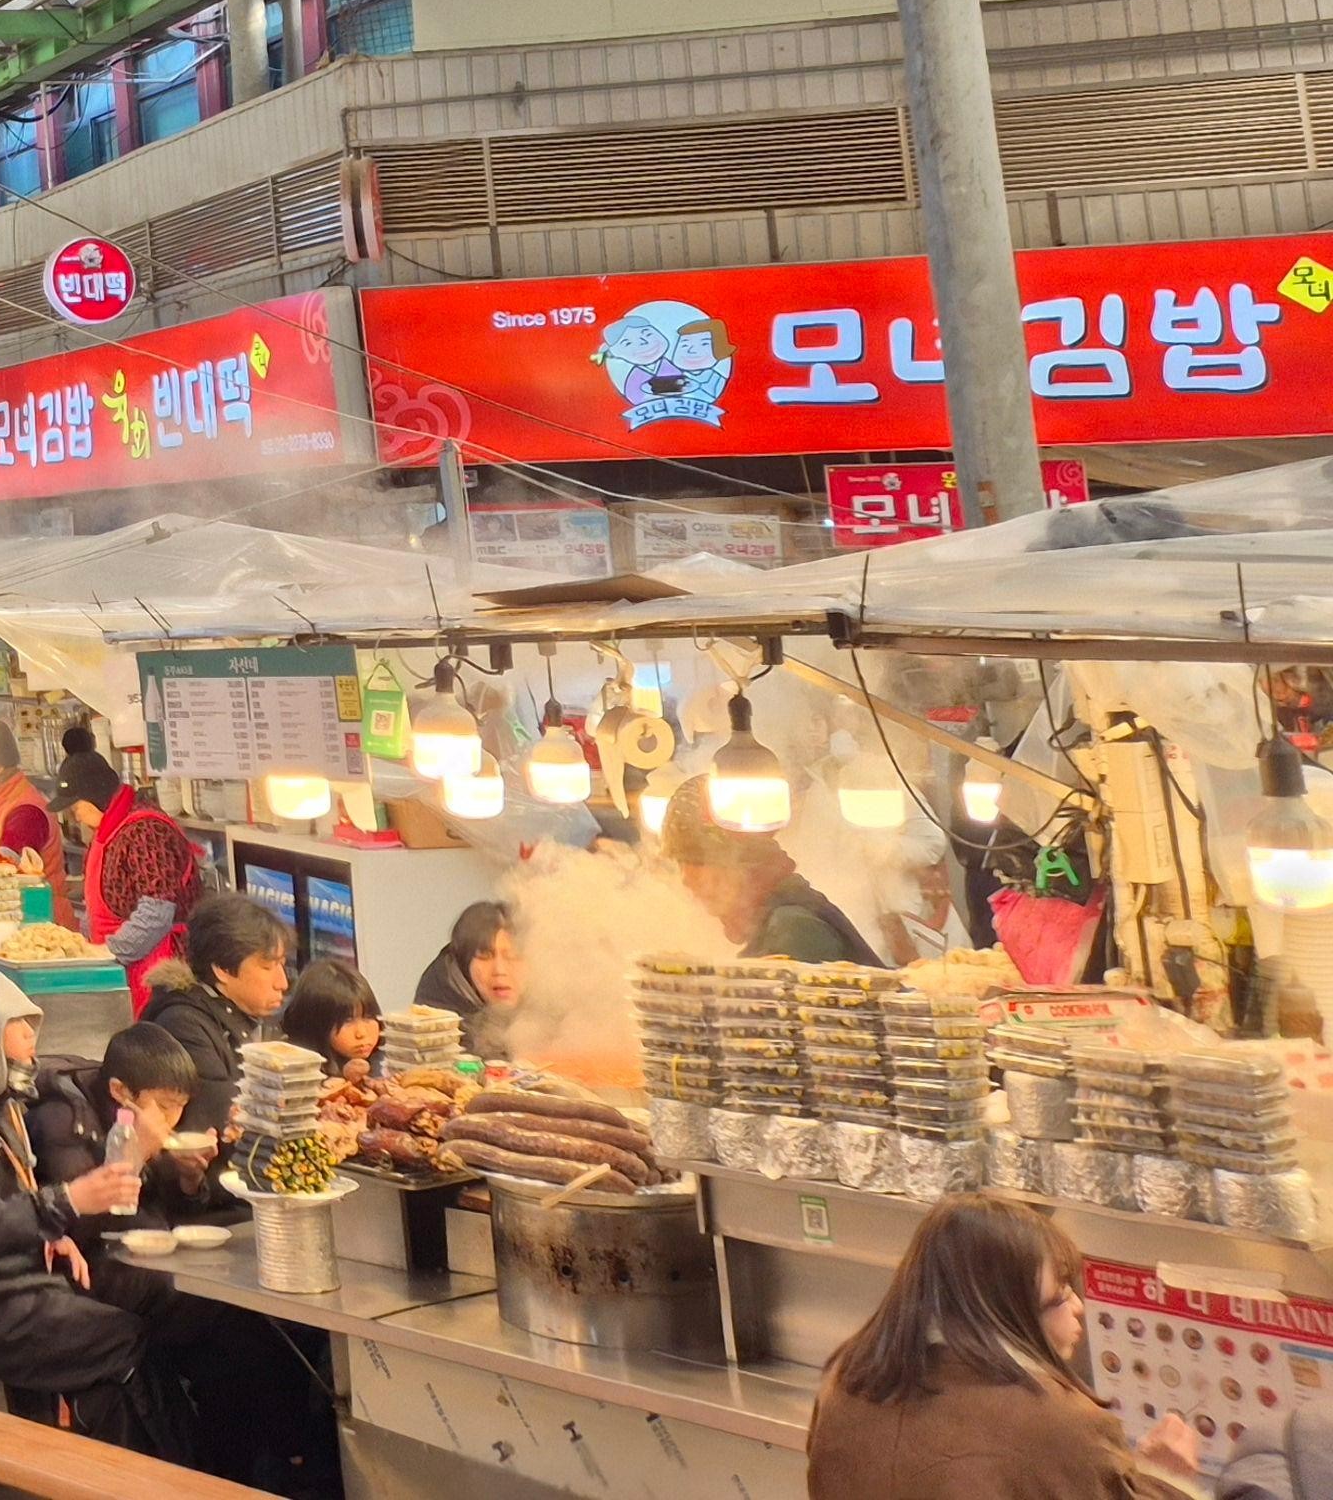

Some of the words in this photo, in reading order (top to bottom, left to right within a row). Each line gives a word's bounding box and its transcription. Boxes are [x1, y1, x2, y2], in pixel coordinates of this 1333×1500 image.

[58, 271, 127, 304] 빈대떡
[1292, 266, 1331, 302] 모녀
[492, 311, 546, 329] Since
[549, 306, 596, 326] 1975
[152, 351, 253, 450] 빈대떡
